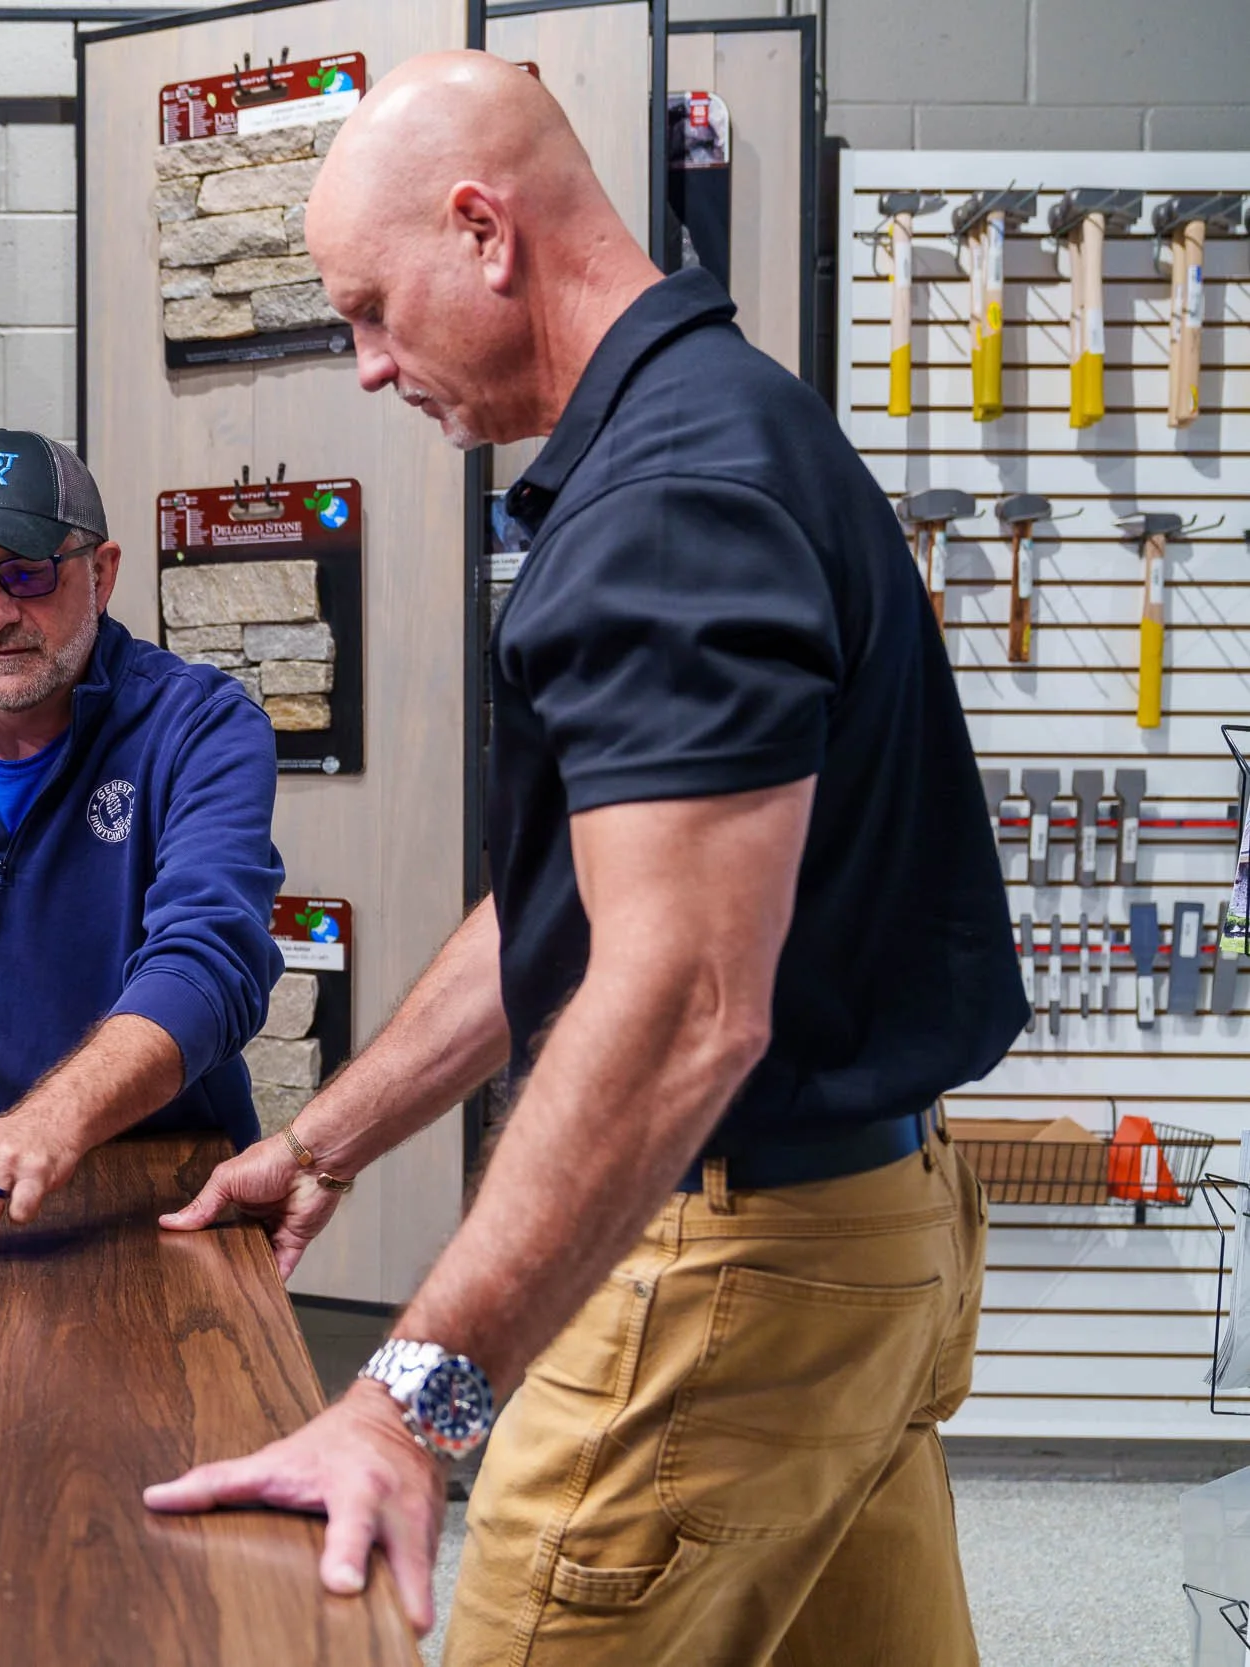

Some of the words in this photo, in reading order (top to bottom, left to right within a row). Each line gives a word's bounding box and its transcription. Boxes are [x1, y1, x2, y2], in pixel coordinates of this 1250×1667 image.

[211, 523, 264, 537] DELGADO
[265, 520, 302, 533] STONE
[97, 782, 133, 800] GENEST
[90, 815, 125, 840] BOOTCAMP
